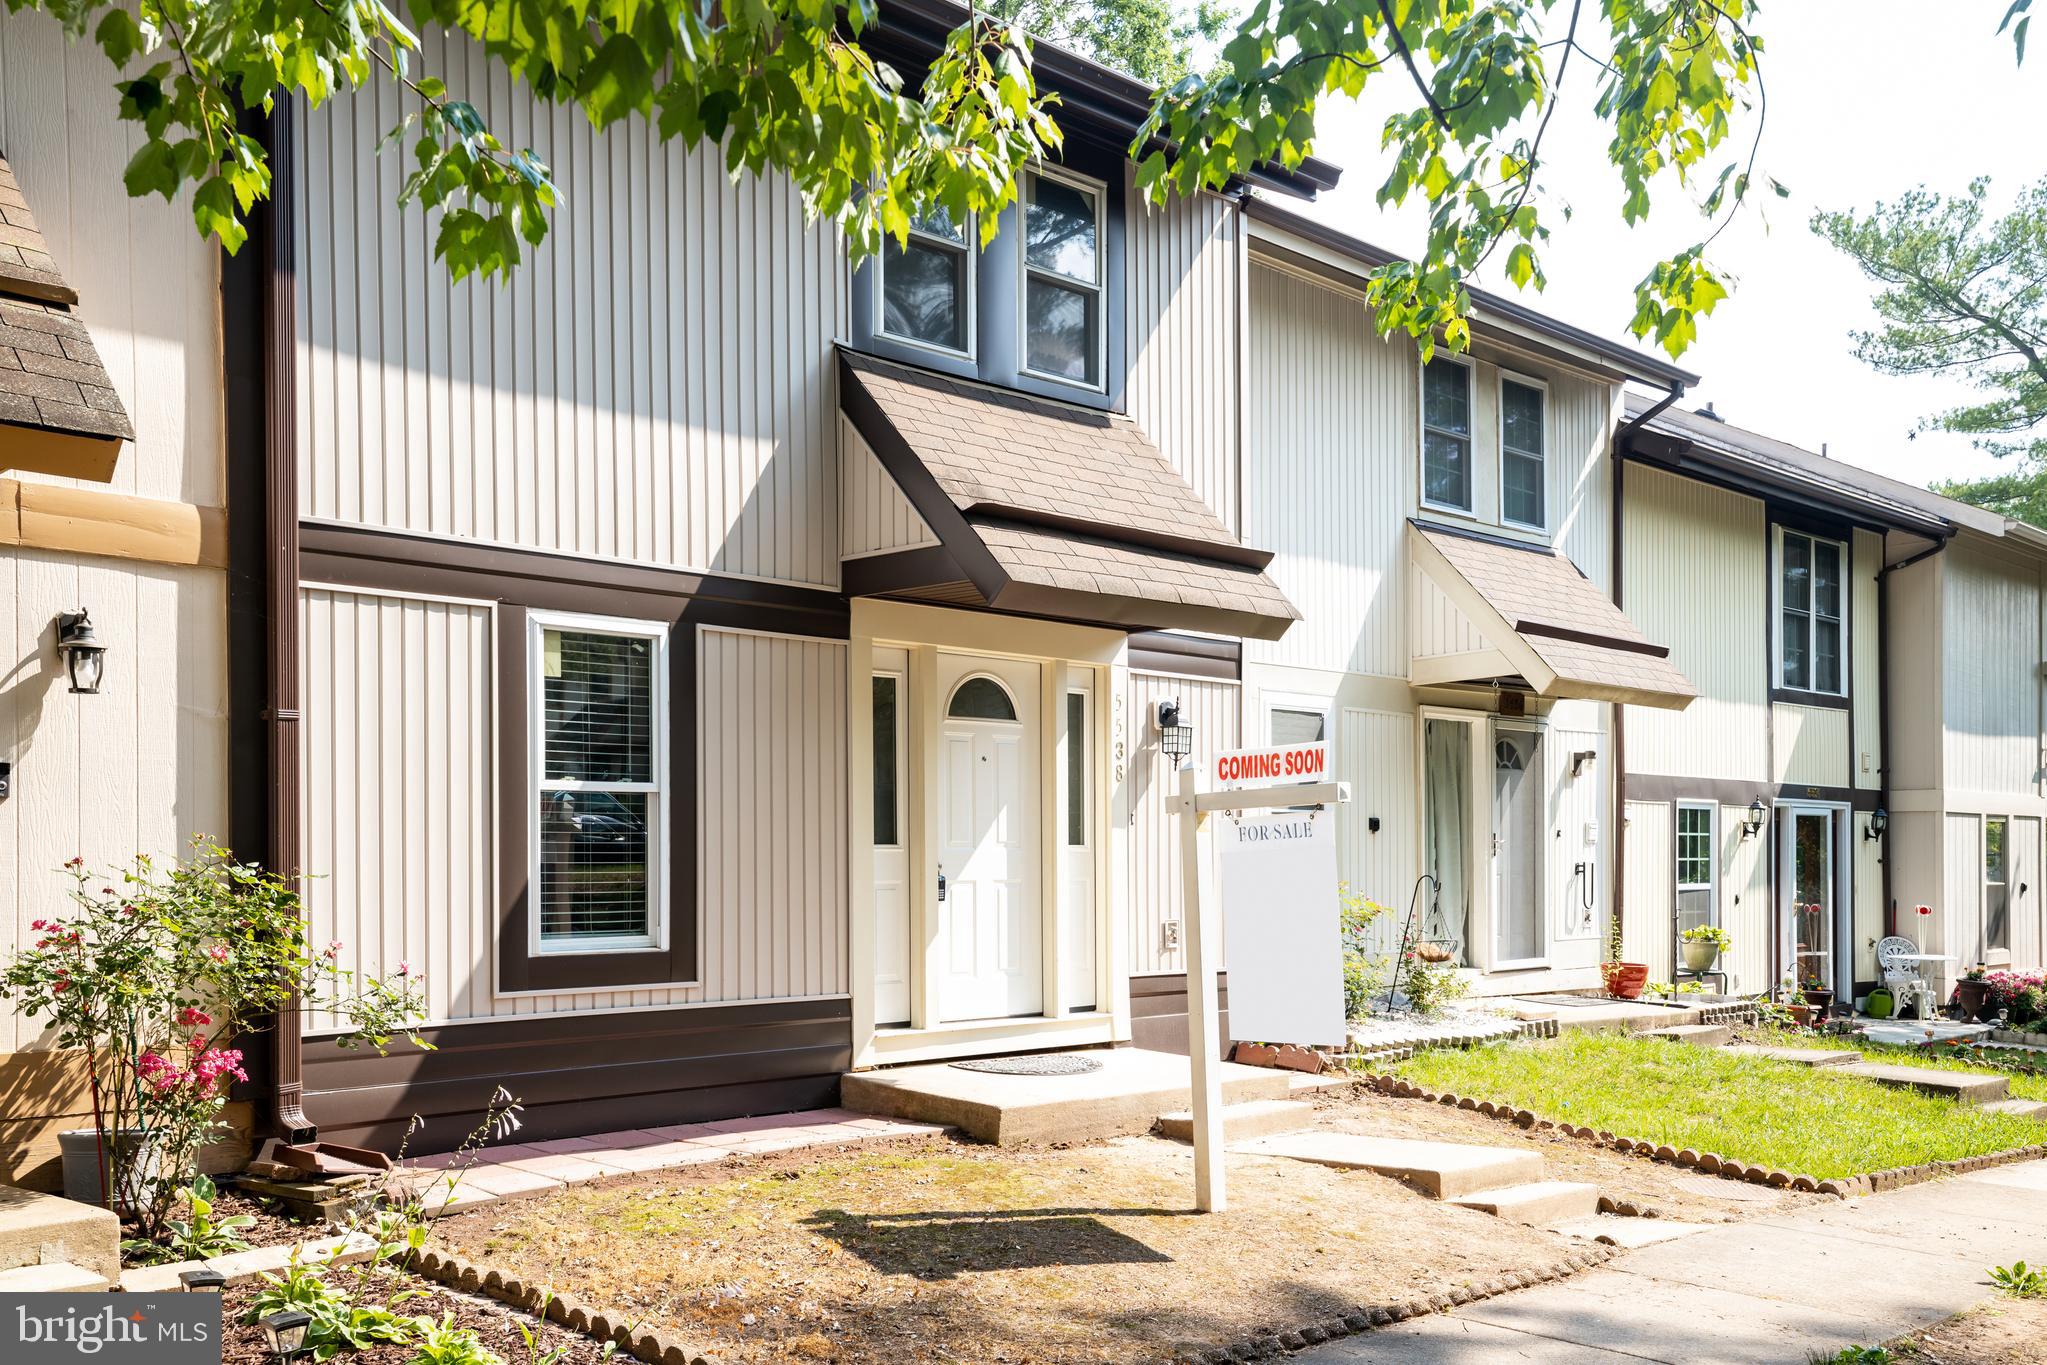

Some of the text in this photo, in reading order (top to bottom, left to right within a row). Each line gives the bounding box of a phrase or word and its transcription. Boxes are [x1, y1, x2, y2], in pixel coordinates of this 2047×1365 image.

[1218, 748, 1324, 781] COMING SOON
[1238, 821, 1313, 842] FOR SALE
